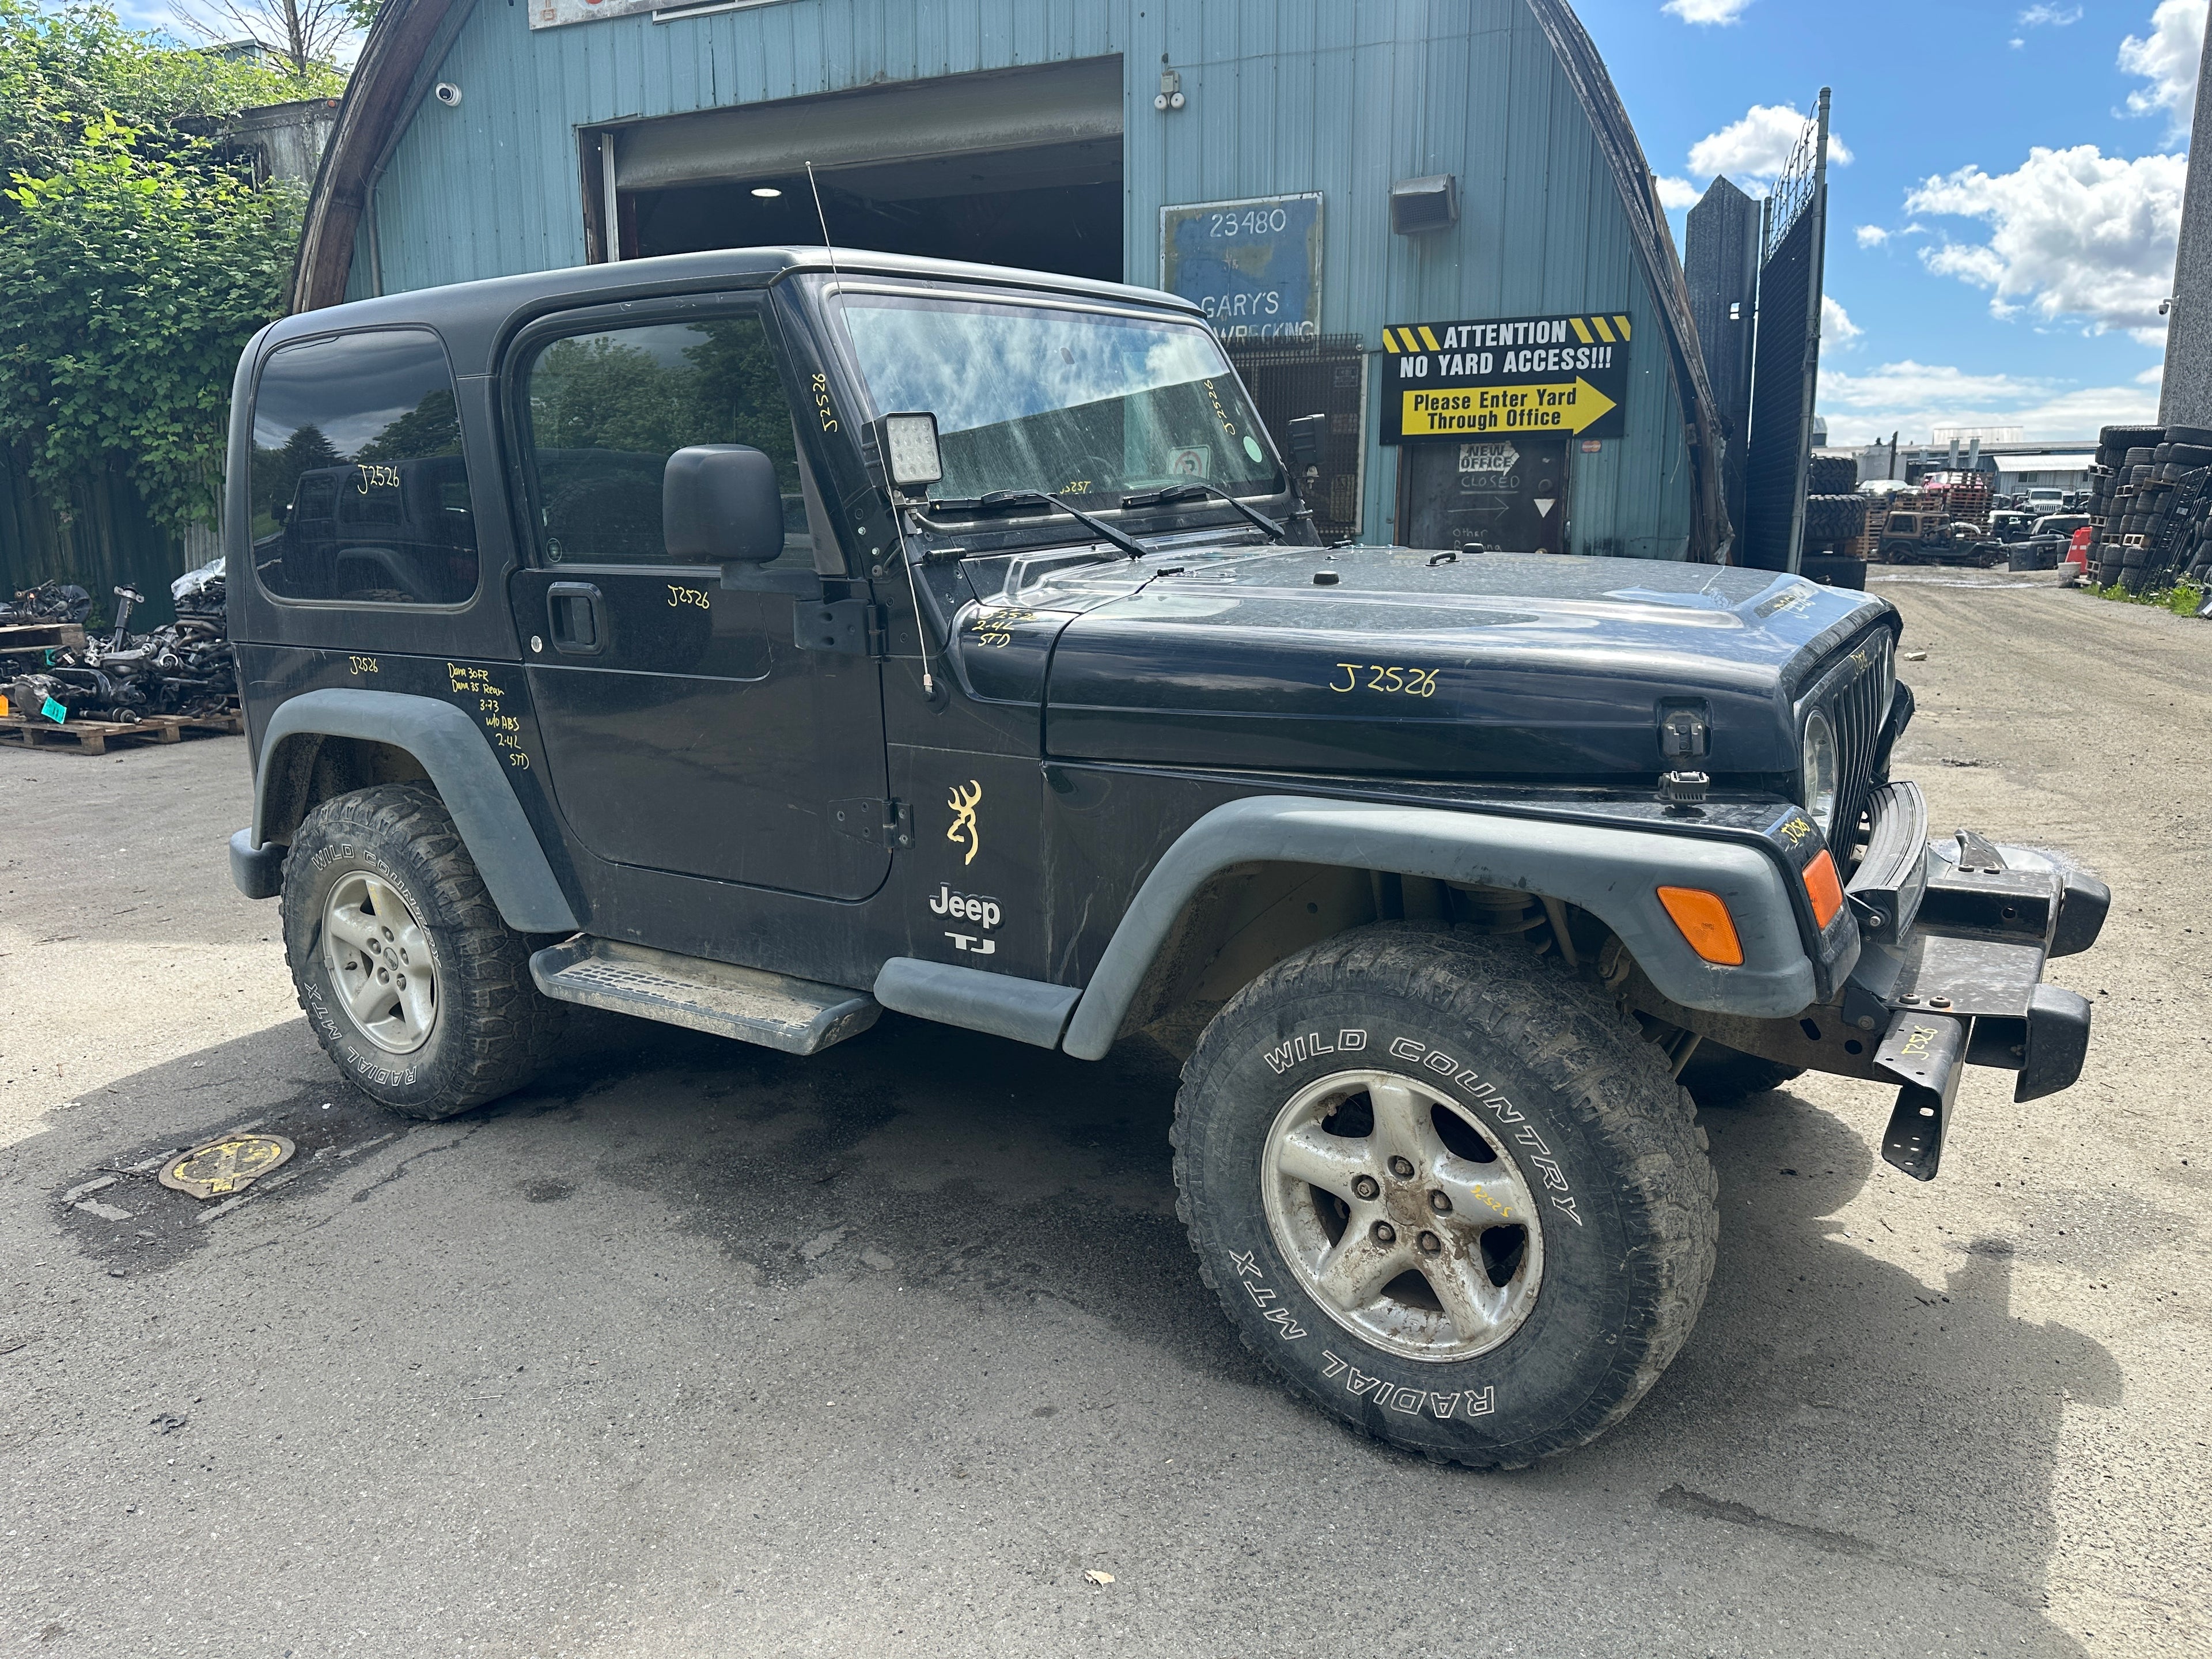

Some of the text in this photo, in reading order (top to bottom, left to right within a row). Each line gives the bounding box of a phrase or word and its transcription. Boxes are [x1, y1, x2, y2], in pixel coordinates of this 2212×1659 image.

[1210, 208, 1286, 237] 23480
[1201, 291, 1279, 319] GARY'S
[1443, 320, 1567, 349] ATTENTION
[1400, 347, 1612, 378] NO YARD ACCESS!!!
[812, 373, 838, 432] J2526
[1204, 379, 1236, 435] J2526
[1414, 387, 1577, 411] Please Enter Yard
[1427, 409, 1561, 431] Through Office
[1461, 457, 1512, 469] OFFICE
[1468, 445, 1505, 456] NEW
[357, 464, 400, 494] J2526
[1461, 475, 1520, 488] CLOSED
[1453, 528, 1488, 537] Other
[667, 584, 710, 609] J2526
[978, 632, 1010, 649] STD
[349, 656, 378, 675] J2526
[447, 662, 467, 679] Dana
[452, 679, 505, 696] Dana 35 Rear
[501, 715, 520, 732] ABS
[312, 843, 443, 968] WILD COUNTRY
[929, 884, 1002, 929] Jeep
[944, 931, 995, 955] TJ
[304, 982, 418, 1086] RADIAL MTX
[1264, 1029, 1583, 1226] WILD COUNTRY
[1228, 1250, 1495, 1419] RADIAL MTX
